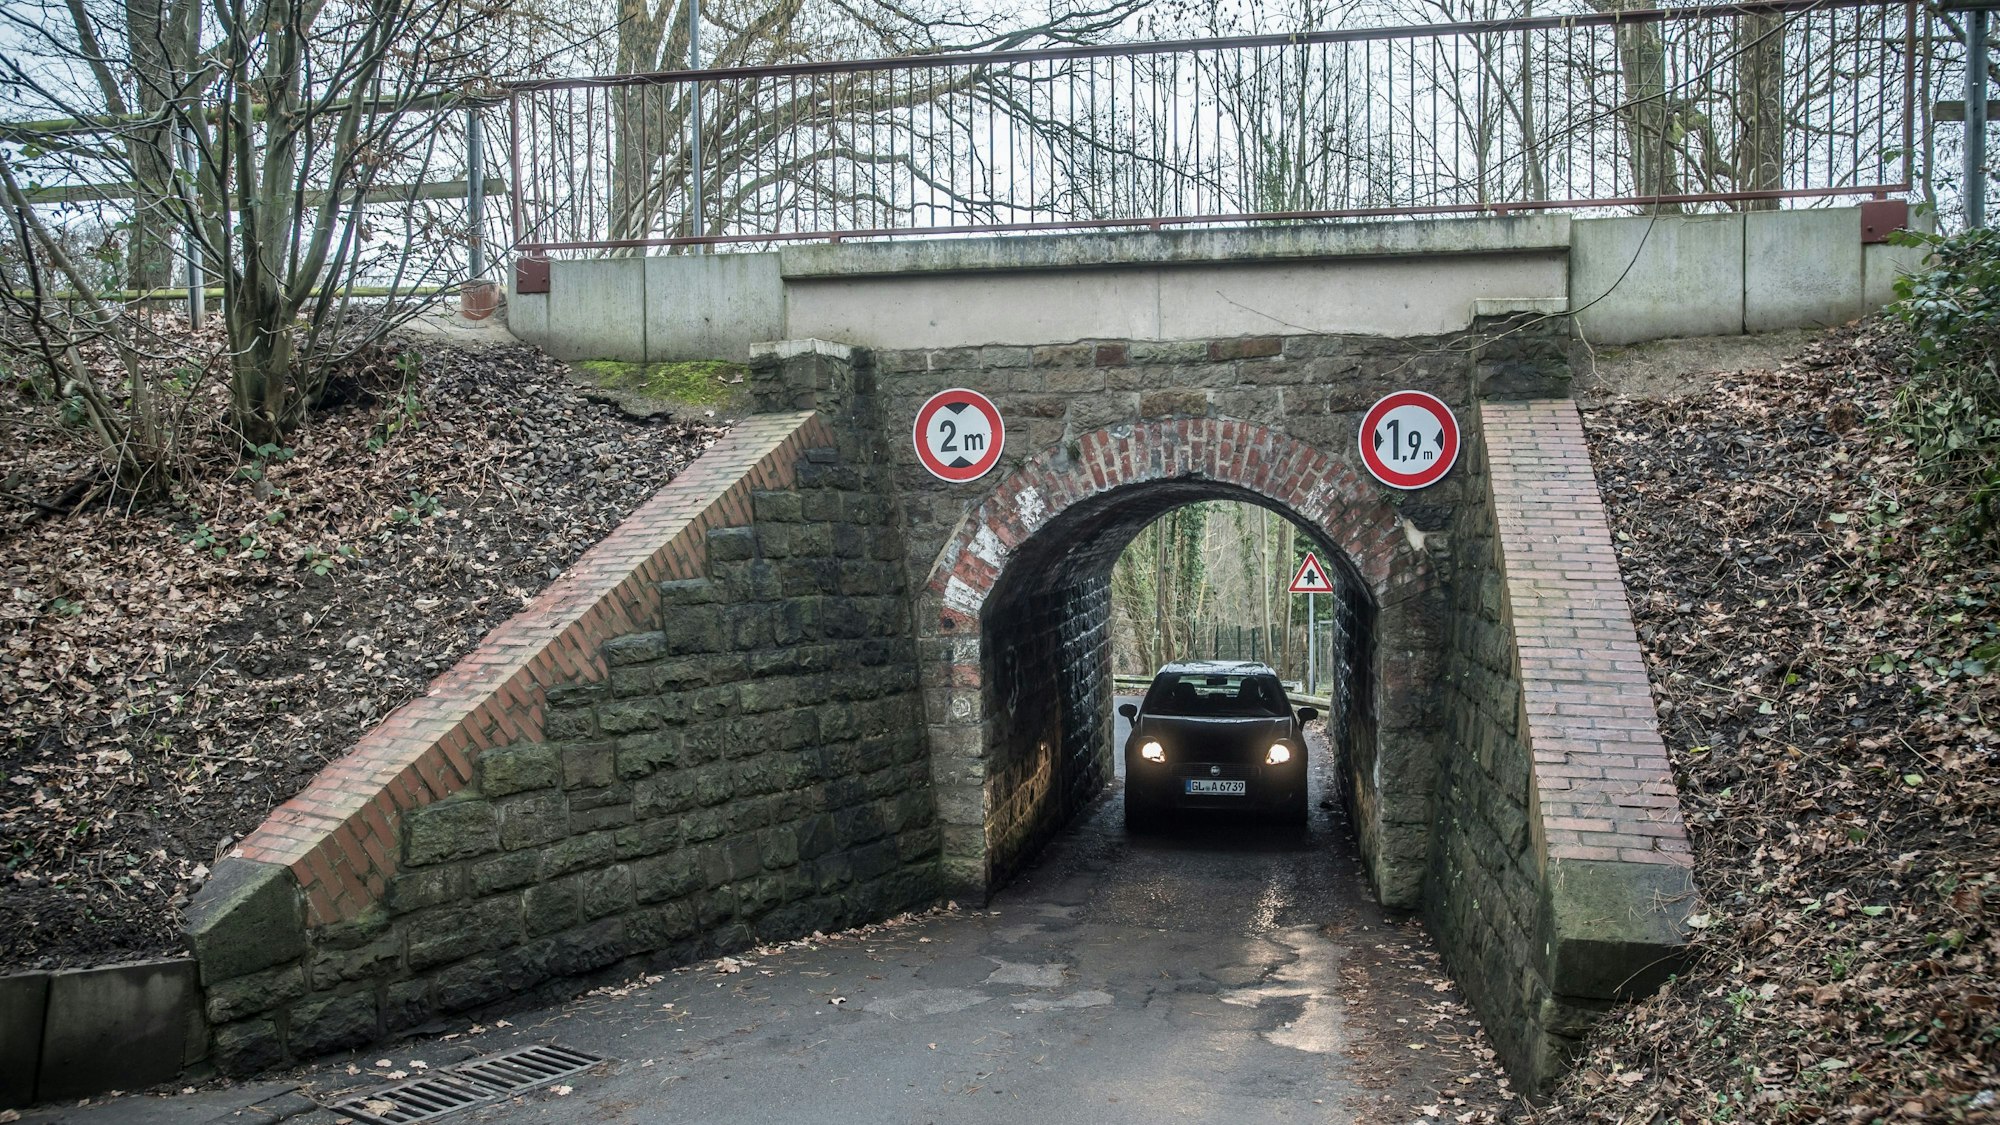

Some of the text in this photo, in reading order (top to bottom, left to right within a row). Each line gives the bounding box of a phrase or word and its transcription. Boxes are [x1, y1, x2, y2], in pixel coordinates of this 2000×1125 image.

[940, 420, 983, 452] 2 m
[1387, 420, 1421, 462] 1,9
[1192, 781, 1244, 791] GL A 6739
